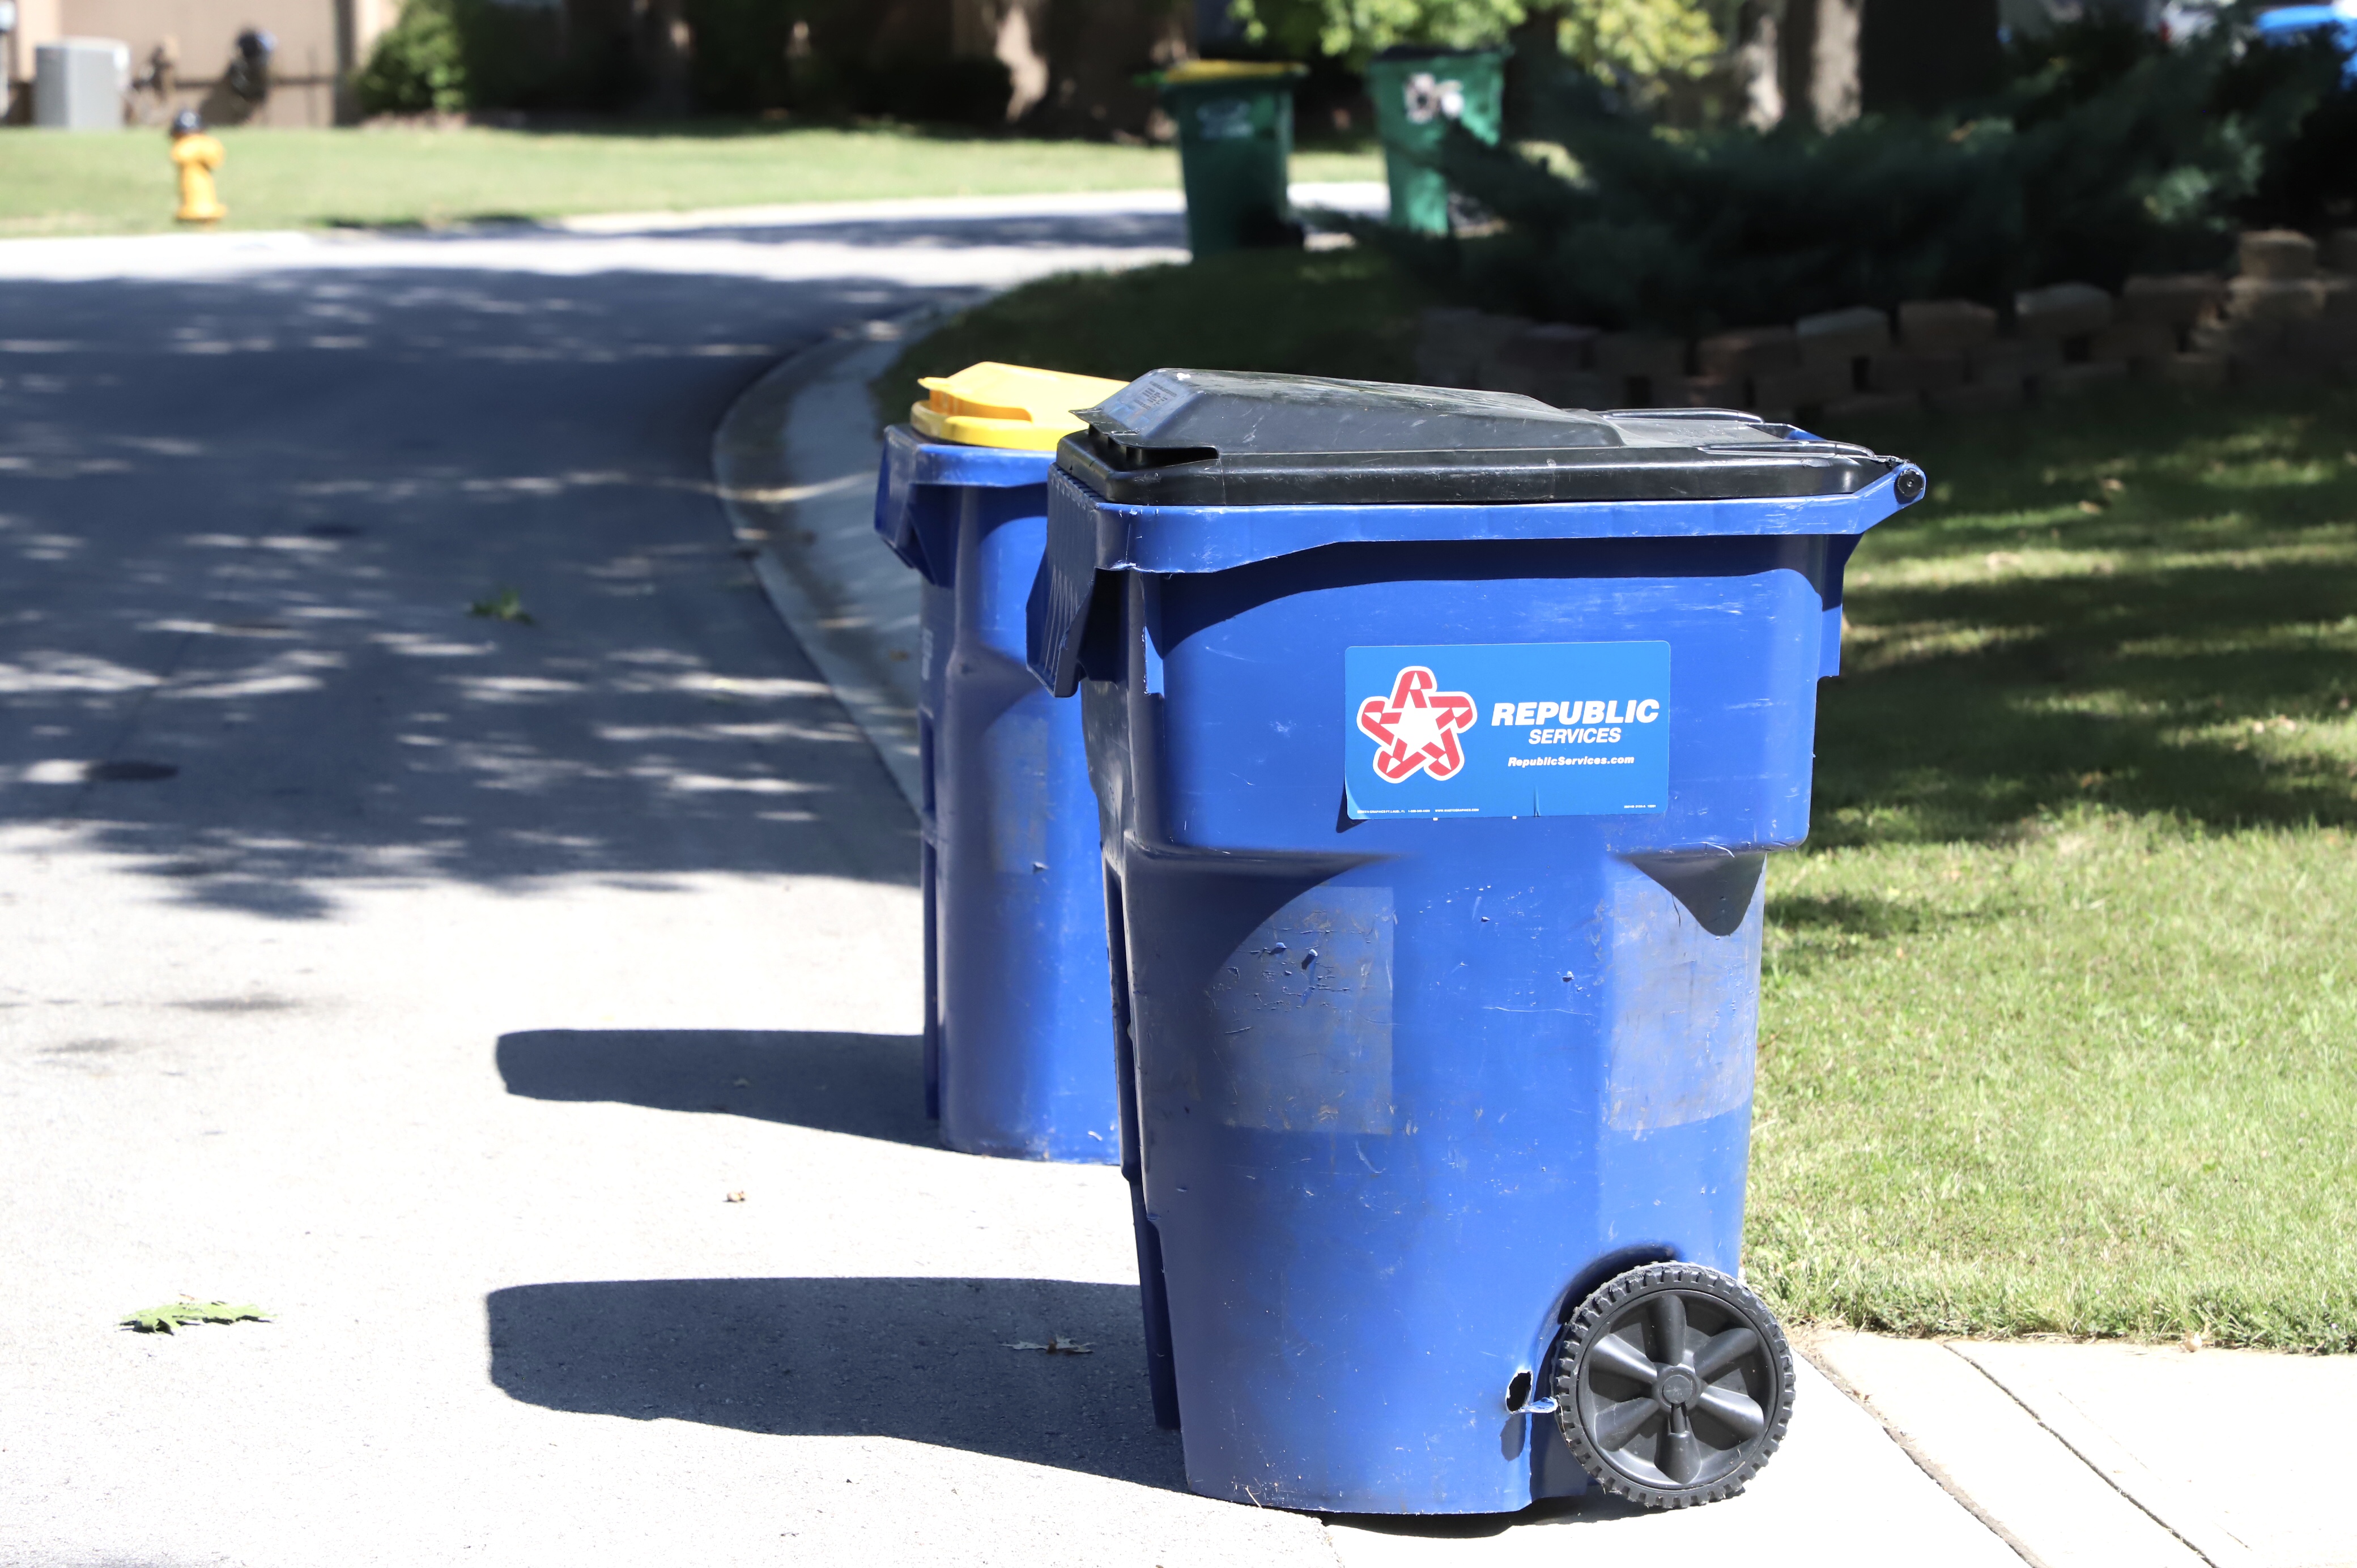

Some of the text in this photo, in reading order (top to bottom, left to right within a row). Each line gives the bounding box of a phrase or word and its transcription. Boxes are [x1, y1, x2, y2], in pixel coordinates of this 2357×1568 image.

[1491, 699, 1660, 726] REPUBLIC
[1528, 727, 1622, 745] SERVICES
[1508, 756, 1635, 768] RepublicServices.com
